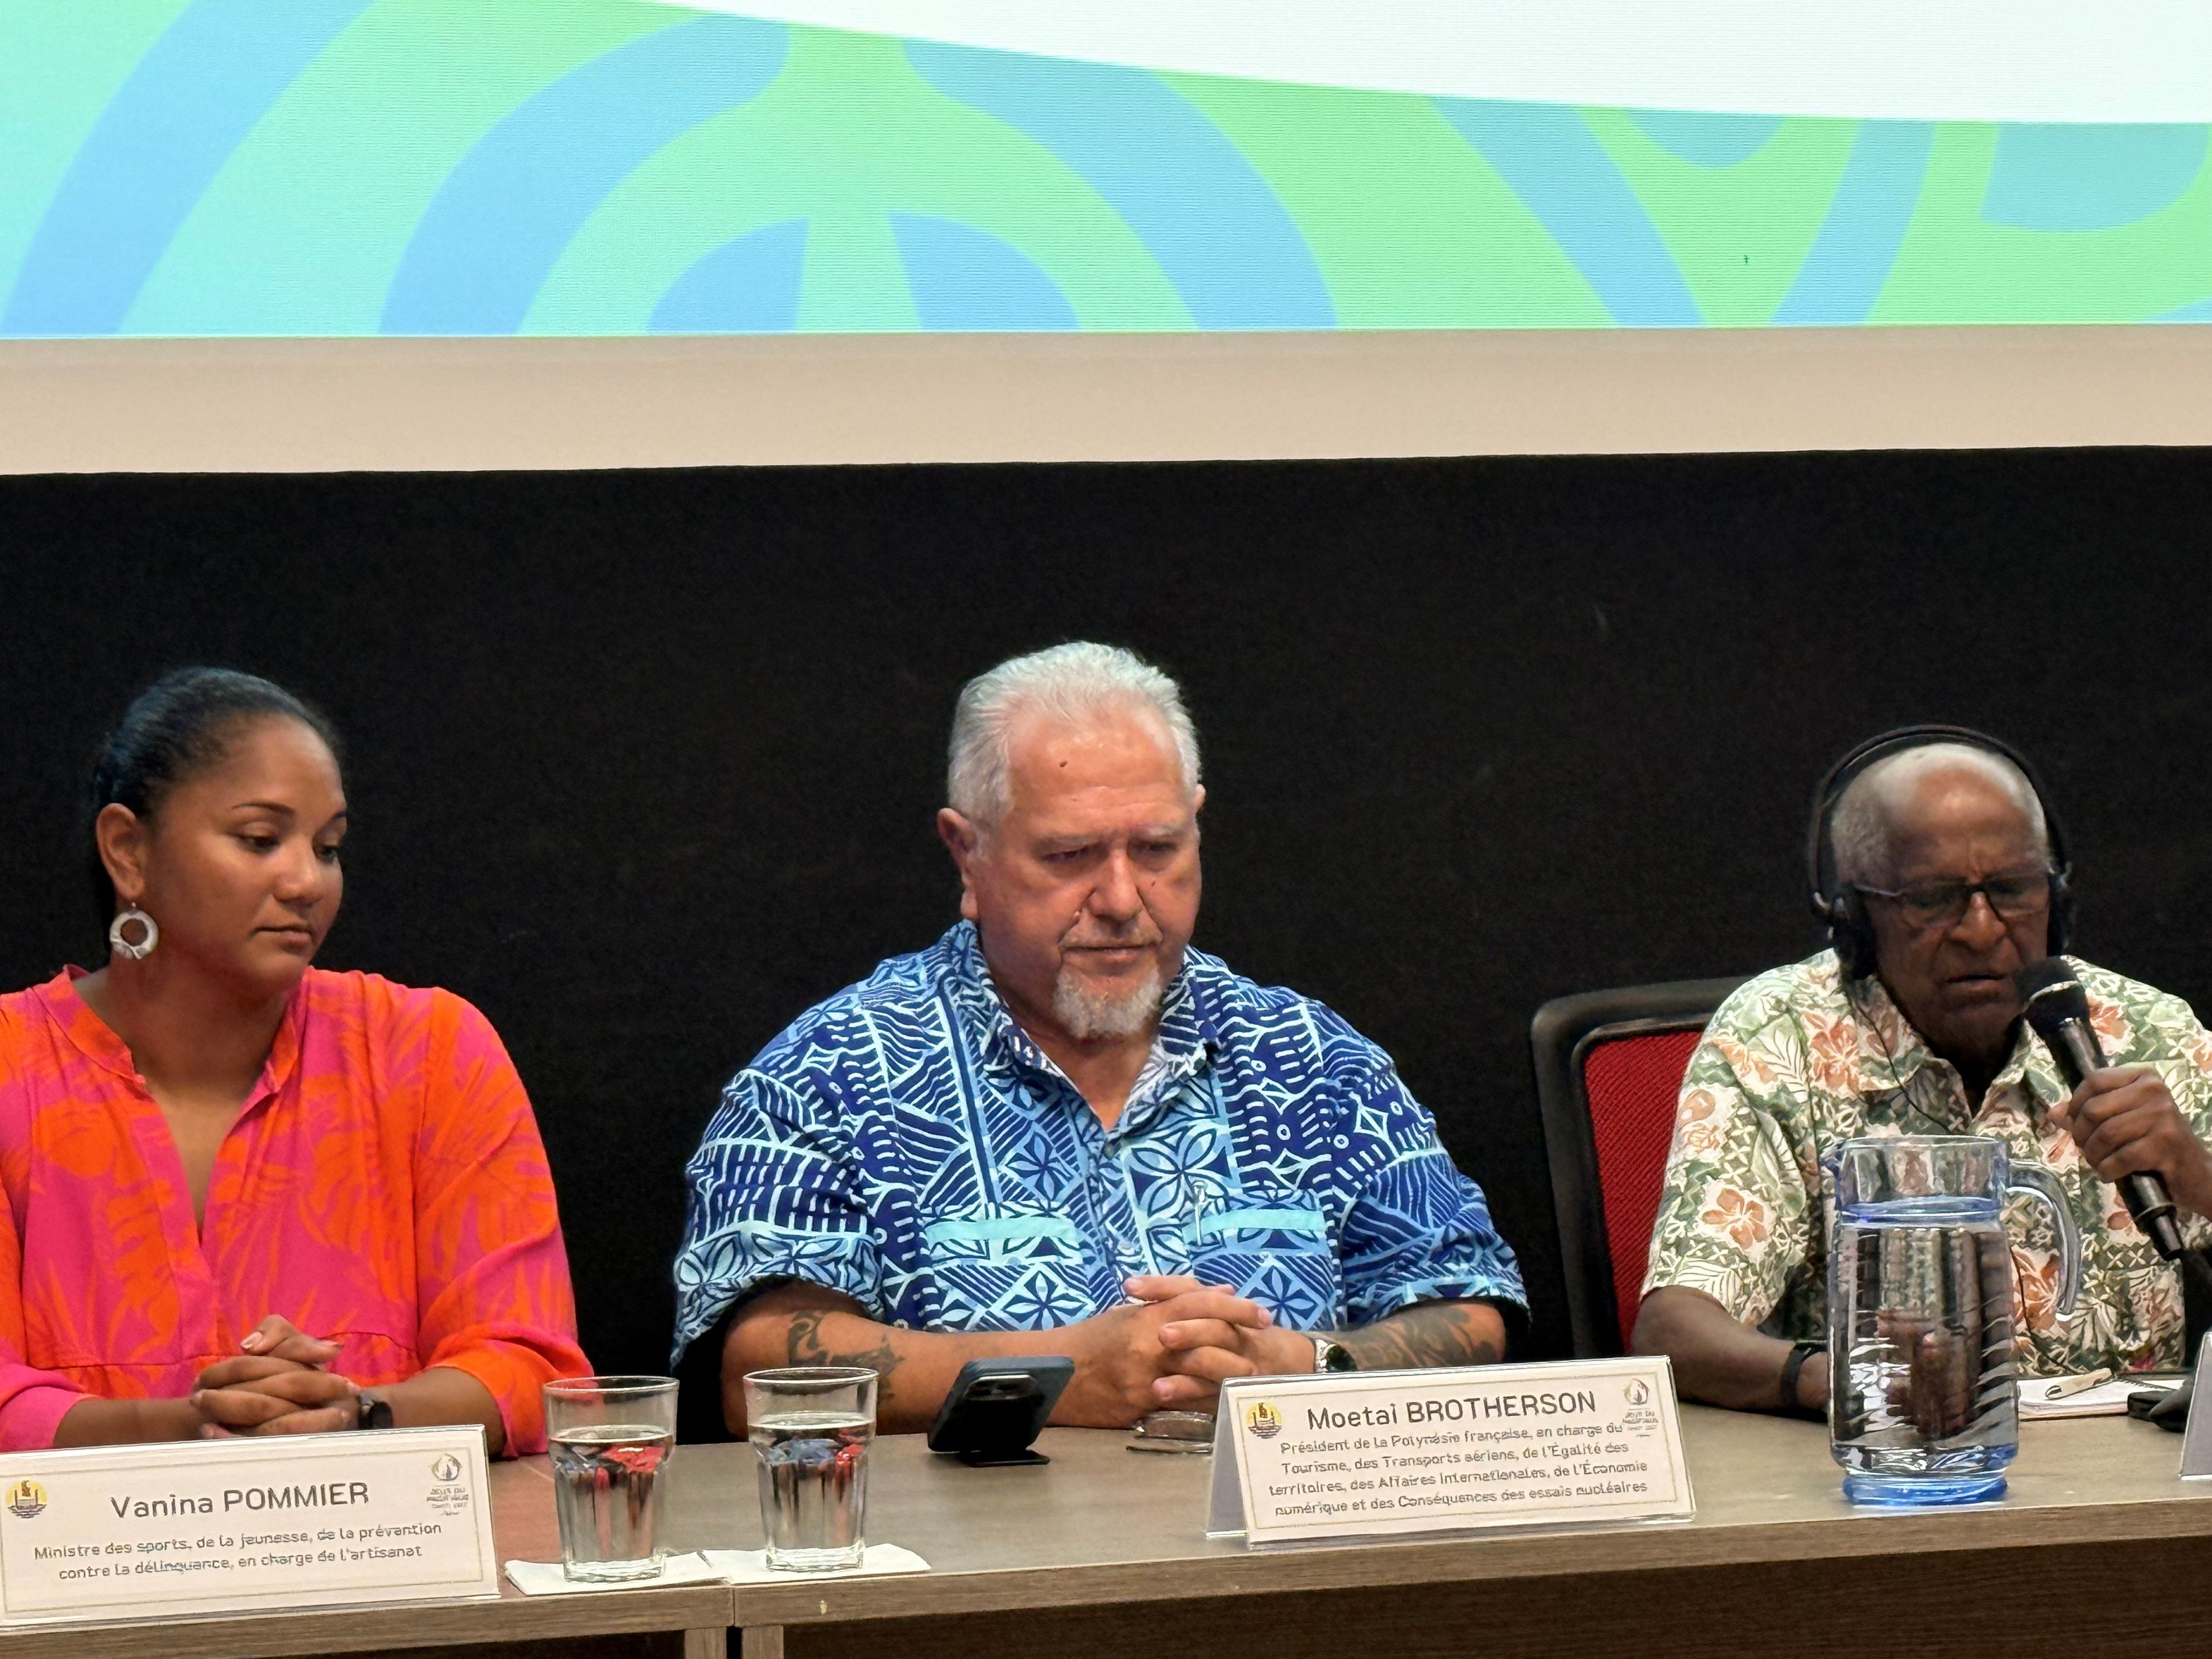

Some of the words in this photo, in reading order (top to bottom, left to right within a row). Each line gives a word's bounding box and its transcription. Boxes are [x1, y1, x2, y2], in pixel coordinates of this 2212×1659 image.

[1307, 1403, 1398, 1430] Moetai
[1406, 1391, 1596, 1423] BROTHERSON
[1280, 1440, 1350, 1454] Président
[1354, 1437, 1370, 1449] de
[1374, 1436, 1388, 1448] la
[1536, 1427, 1553, 1437] en
[1556, 1424, 1602, 1438] charge
[1606, 1423, 1623, 1433] du
[1281, 1462, 1352, 1475] Tourisme,
[1355, 1458, 1379, 1469] des
[1382, 1453, 1462, 1468] Transports
[1465, 1449, 1519, 1463] aériens,
[1522, 1447, 1538, 1459] de
[1542, 1442, 1601, 1459] l'Égalité
[1605, 1442, 1629, 1453] des
[1269, 1481, 1347, 1496] territoires,
[1350, 1479, 1375, 1490] des
[1378, 1475, 1436, 1489] Affaires
[1554, 1465, 1570, 1477] de
[110, 1493, 213, 1519] Vanina
[224, 1482, 369, 1513] POMMIER
[1275, 1501, 1348, 1516] numérique
[1352, 1499, 1367, 1511] et
[1370, 1498, 1395, 1509] des
[1398, 1492, 1498, 1509] Conséquences
[1501, 1489, 1525, 1502] des
[1529, 1486, 1572, 1498] essais
[1576, 1481, 1647, 1496] nucléaires
[35, 1544, 100, 1560] Ministre
[104, 1542, 132, 1555] des
[137, 1538, 192, 1555] sports,
[196, 1536, 215, 1548] de
[219, 1534, 234, 1547] la
[239, 1533, 313, 1549] jeunesse,
[317, 1528, 336, 1541] de
[339, 1527, 354, 1540] la
[359, 1523, 442, 1542] prévention
[59, 1566, 110, 1580] contre
[115, 1563, 131, 1576] la
[135, 1559, 234, 1576] délinquance,
[238, 1557, 257, 1567] en
[261, 1553, 313, 1566] charge
[317, 1549, 336, 1562] de
[340, 1545, 423, 1561] l'artisanat
